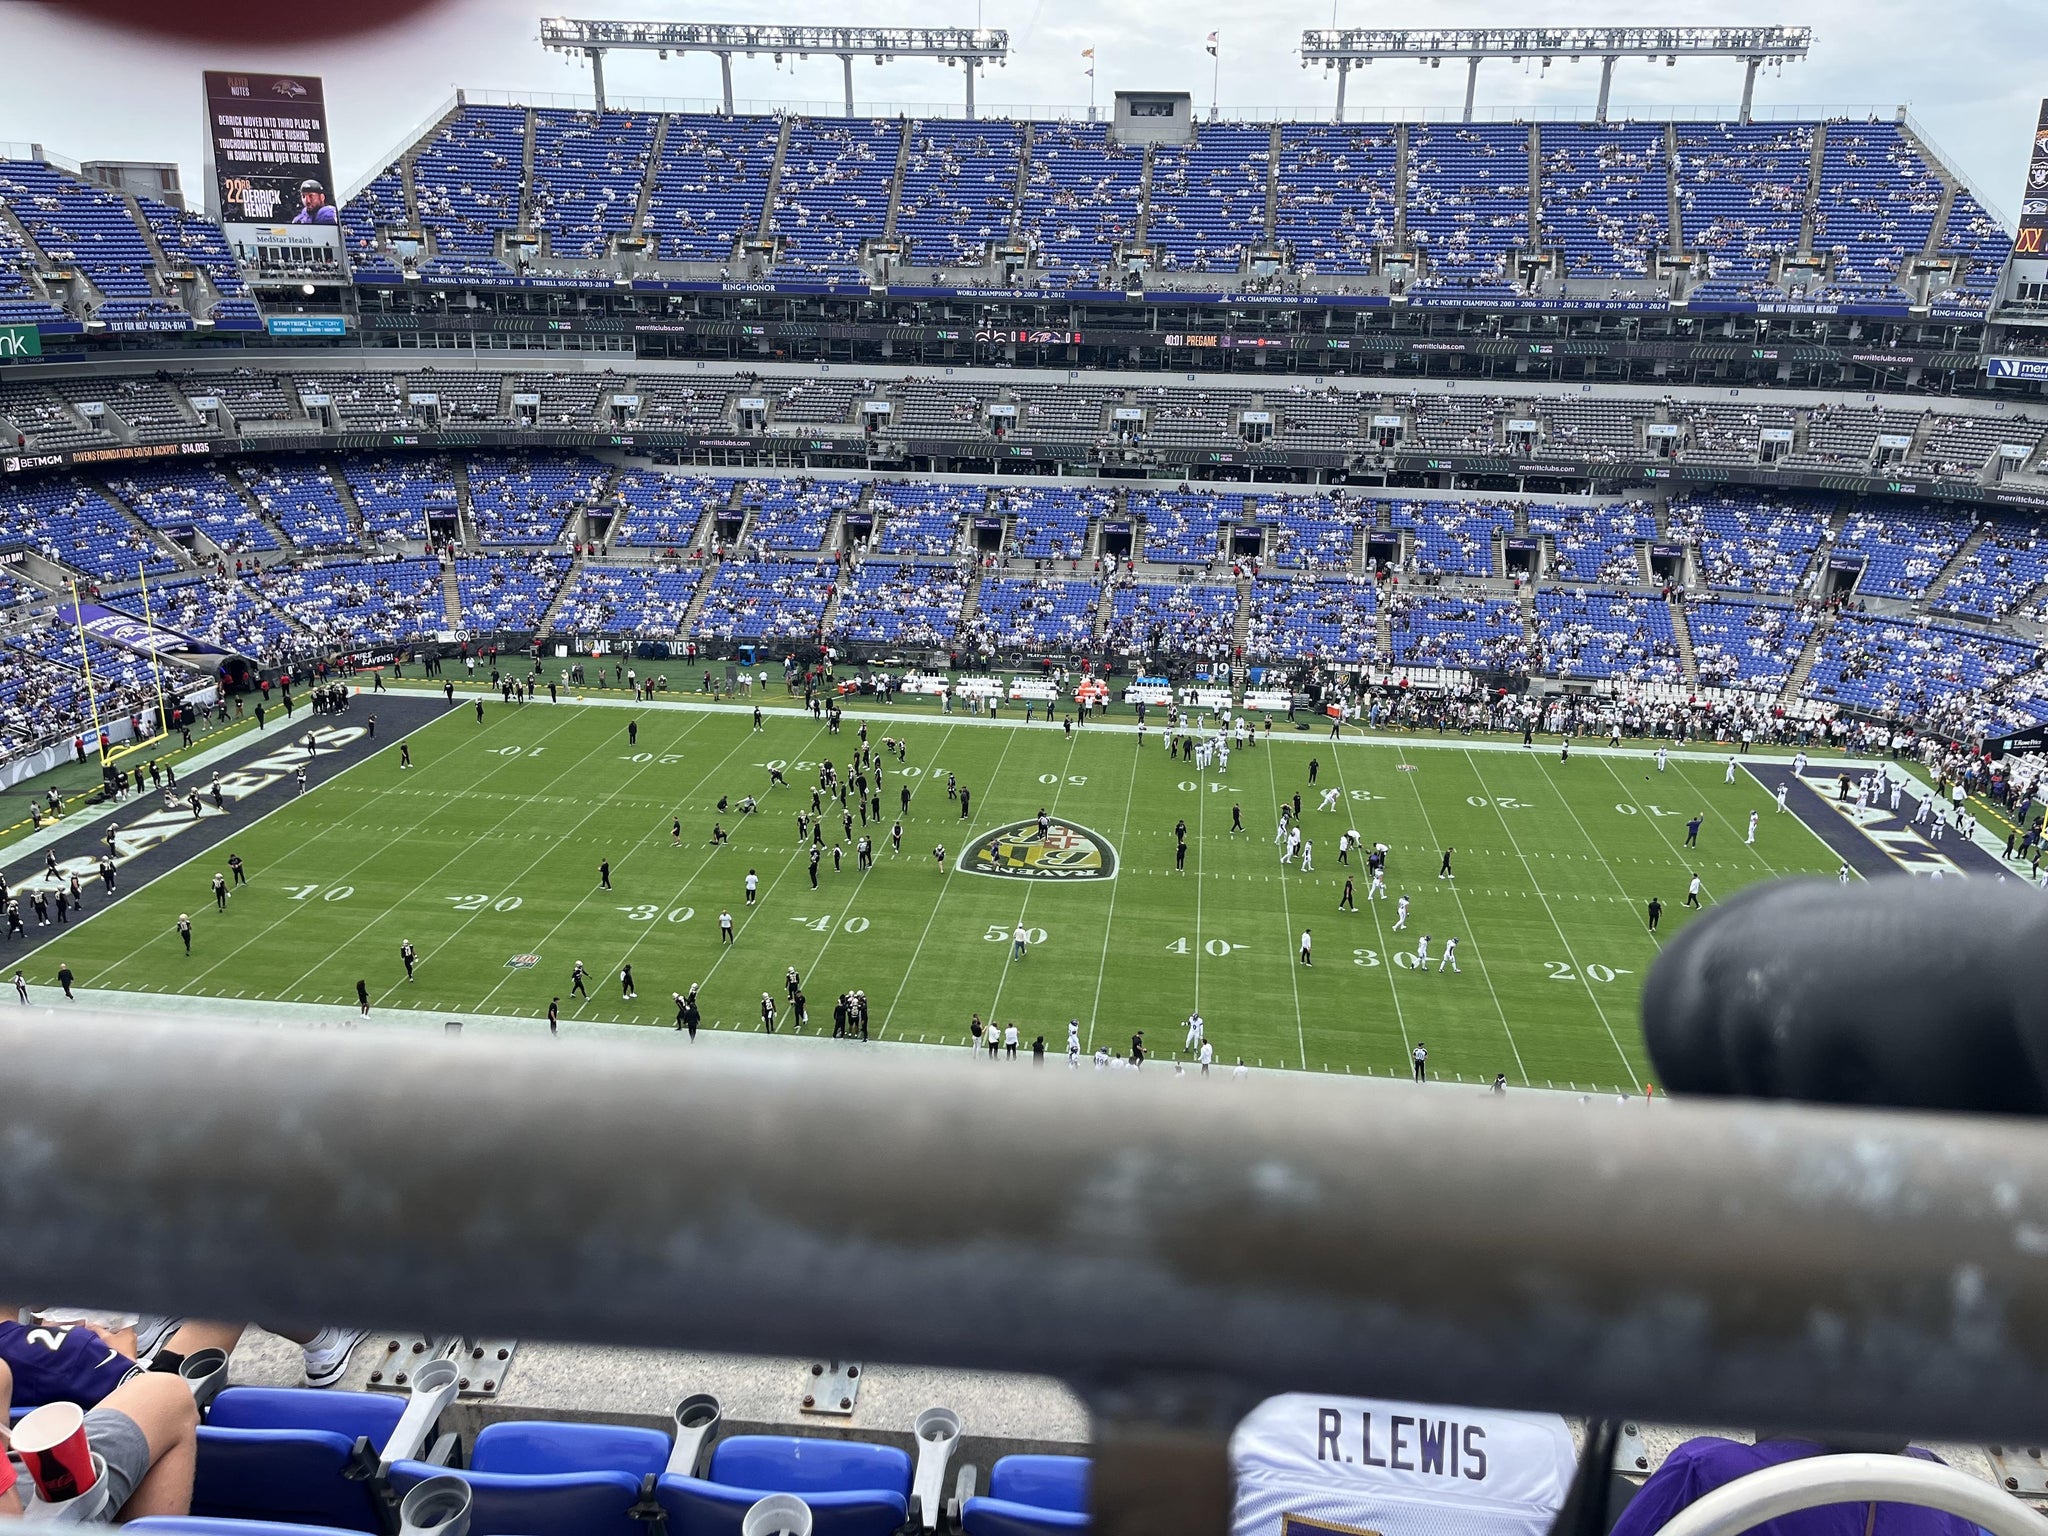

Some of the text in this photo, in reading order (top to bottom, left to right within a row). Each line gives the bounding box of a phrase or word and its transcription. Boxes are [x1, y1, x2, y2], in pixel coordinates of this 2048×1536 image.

[228, 78, 248, 86] PLAYER
[231, 87, 250, 96] NOTES
[218, 115, 320, 130] DERRICK MOVED INTO THIRD PLACE ON
[232, 128, 309, 140] THE NFL'S ALL-TIME RUSHING
[218, 139, 325, 153] TOUCHDOWNS LIST WITH THREE SCORES
[227, 151, 320, 164] IN SUNDAY'S WIN OVER THE COLTS.
[226, 179, 251, 203] 22 RB
[242, 189, 281, 204] DERRICK
[244, 203, 273, 217] HENRY
[256, 236, 313, 244] MedStar Health
[428, 277, 456, 285] MARSHAL
[481, 278, 514, 286] 2007-2019
[722, 283, 776, 292] RING HONOR
[1757, 304, 1774, 312] THANK
[1786, 305, 1814, 313] FRONTLINE
[1815, 305, 1838, 314] HEROES!
[1955, 311, 1983, 319] HONOR
[124, 322, 135, 330] FOR
[136, 322, 148, 330] HELP
[635, 324, 685, 333] merrittclubs.com
[1011, 331, 1016, 342] 0
[1066, 333, 1070, 343] 0
[1164, 335, 1217, 346] 40:01 PREGAME
[1412, 342, 1465, 351] merrittclubs.com
[1852, 354, 1914, 363] merrittclubs.com
[699, 439, 751, 447] merrittclubs.com
[20, 443, 209, 468] BETMGM RAVENS FOUNDATION 50/50 JACKPOT: $14,035
[1519, 464, 1575, 473] merrittclubs.com
[11, 552, 23, 563] BAY
[1196, 663, 1208, 672] EST
[1038, 773, 1088, 786] 50
[976, 863, 1099, 876] RAVENS
[983, 924, 1048, 945] 50
[1165, 937, 1231, 957] 40
[1543, 961, 1616, 982] 20
[1318, 1408, 1487, 1481] R.LEWIS
